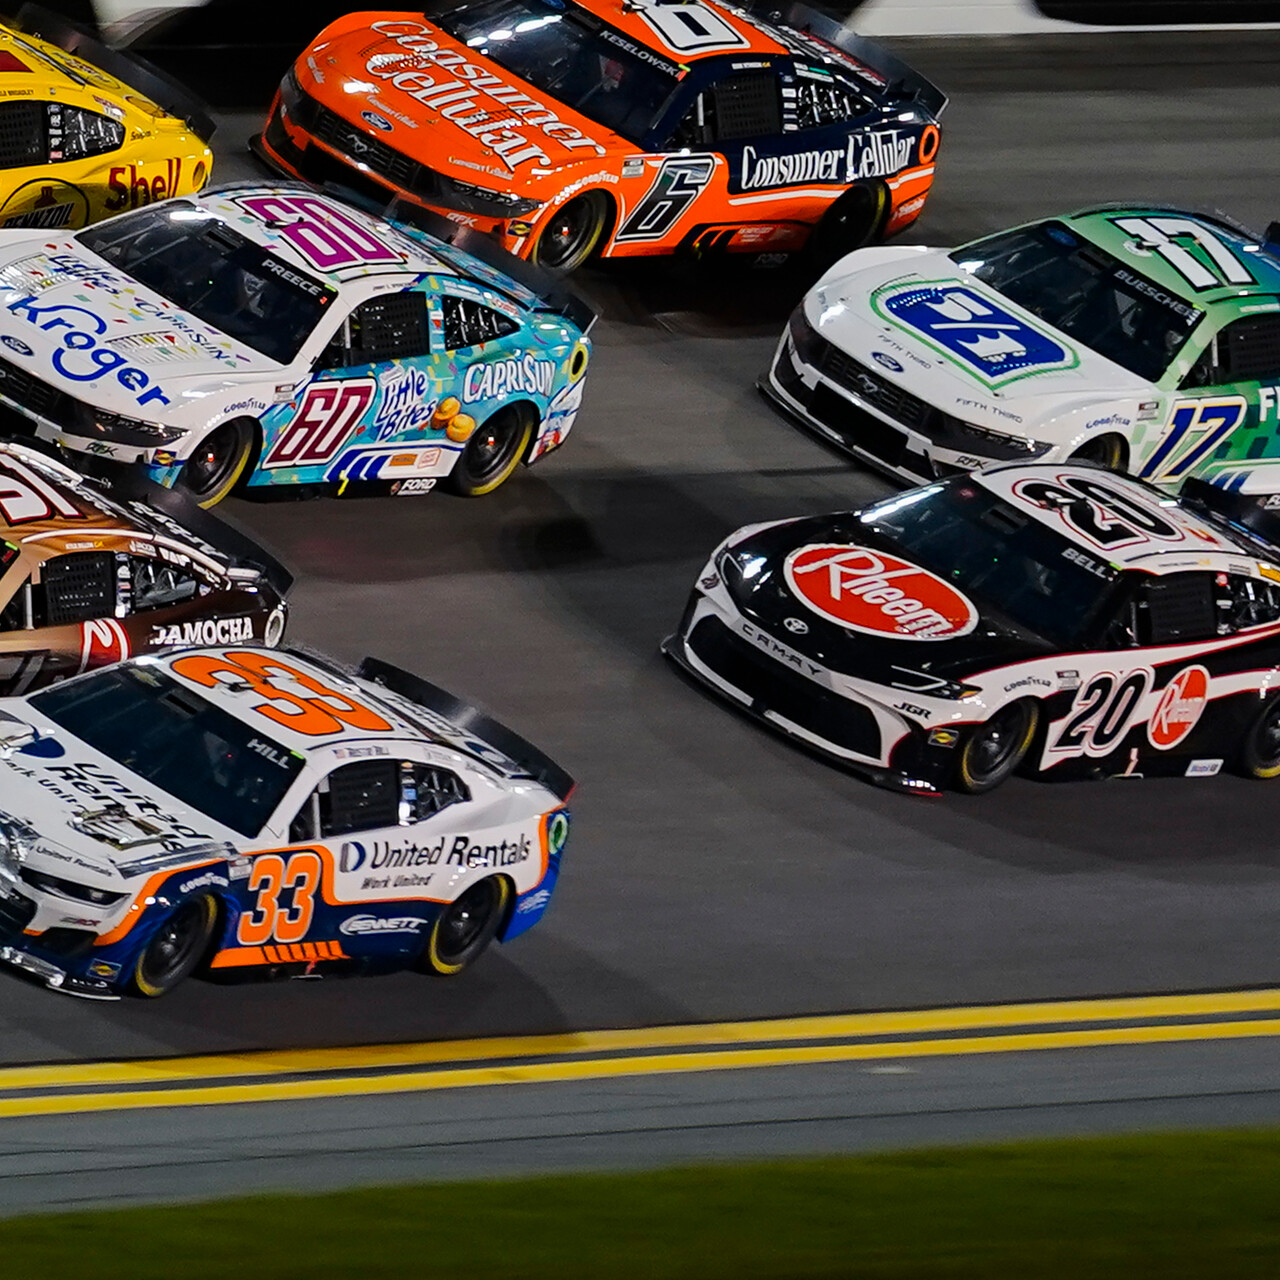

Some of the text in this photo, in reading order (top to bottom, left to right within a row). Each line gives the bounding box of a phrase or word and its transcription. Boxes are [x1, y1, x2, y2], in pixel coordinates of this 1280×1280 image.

[365, 53, 551, 173] Cellular
[371, 20, 607, 157] Consumer
[104, 157, 181, 212] Shell
[740, 130, 916, 190] Consumer Cellular
[615, 154, 716, 242] 6
[232, 194, 408, 272] 60
[1106, 217, 1260, 293] 17
[262, 258, 321, 297] PREECE
[7, 294, 172, 407] Kroger
[878, 334, 932, 370] FIFTH THIRD
[262, 378, 377, 469] 60
[375, 369, 426, 424] Little
[378, 400, 436, 441] Bites
[955, 398, 1023, 424] FIFTH THIRD
[1140, 395, 1247, 485] 17
[401, 479, 437, 491] FORD
[1014, 476, 1183, 549] 20
[1061, 547, 1107, 578] BELL
[793, 550, 953, 638] Rheem
[149, 617, 253, 645] JAMOCHA
[741, 621, 822, 676] CAMRY
[171, 652, 393, 736] 33
[894, 701, 931, 720] JGR
[1049, 669, 1153, 753] 20
[246, 738, 290, 770] HILL
[35, 846, 72, 863] United
[371, 832, 532, 870] United Rentals
[237, 852, 321, 945] 33
[361, 873, 432, 890] Work United
